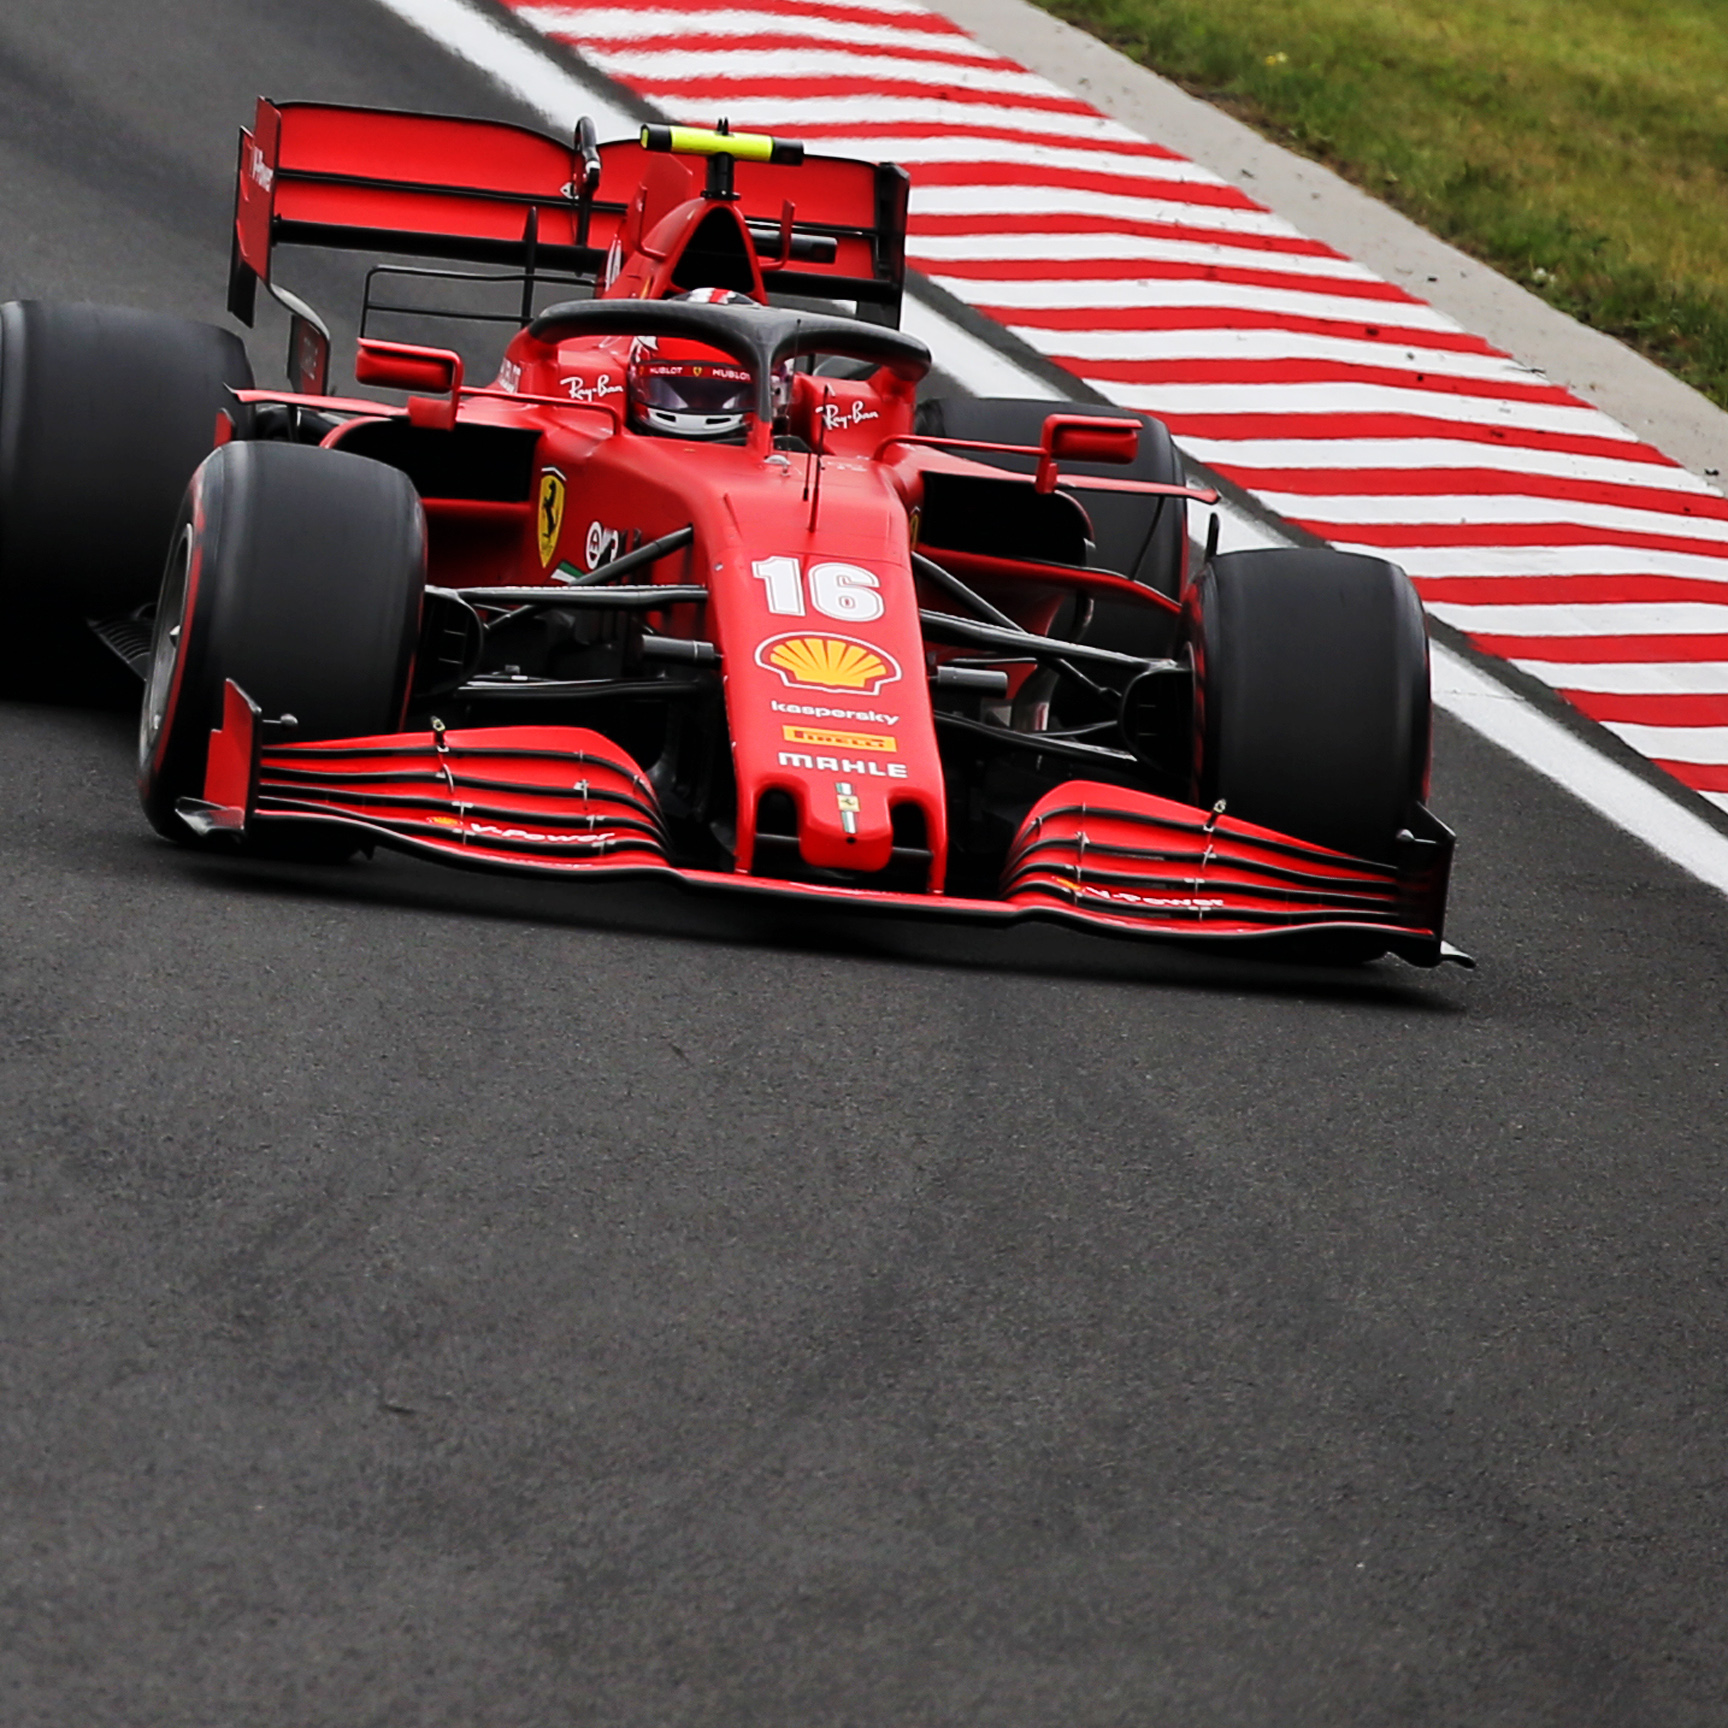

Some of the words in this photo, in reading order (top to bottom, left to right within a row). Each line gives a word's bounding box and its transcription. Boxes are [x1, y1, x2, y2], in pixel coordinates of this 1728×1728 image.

[560, 374, 624, 403] Ray-Ban
[815, 400, 879, 431] Ray-Ban
[751, 555, 885, 622] 16
[770, 700, 900, 726] kaspersky
[777, 752, 908, 779] MAHLE
[471, 822, 615, 843] V-Power
